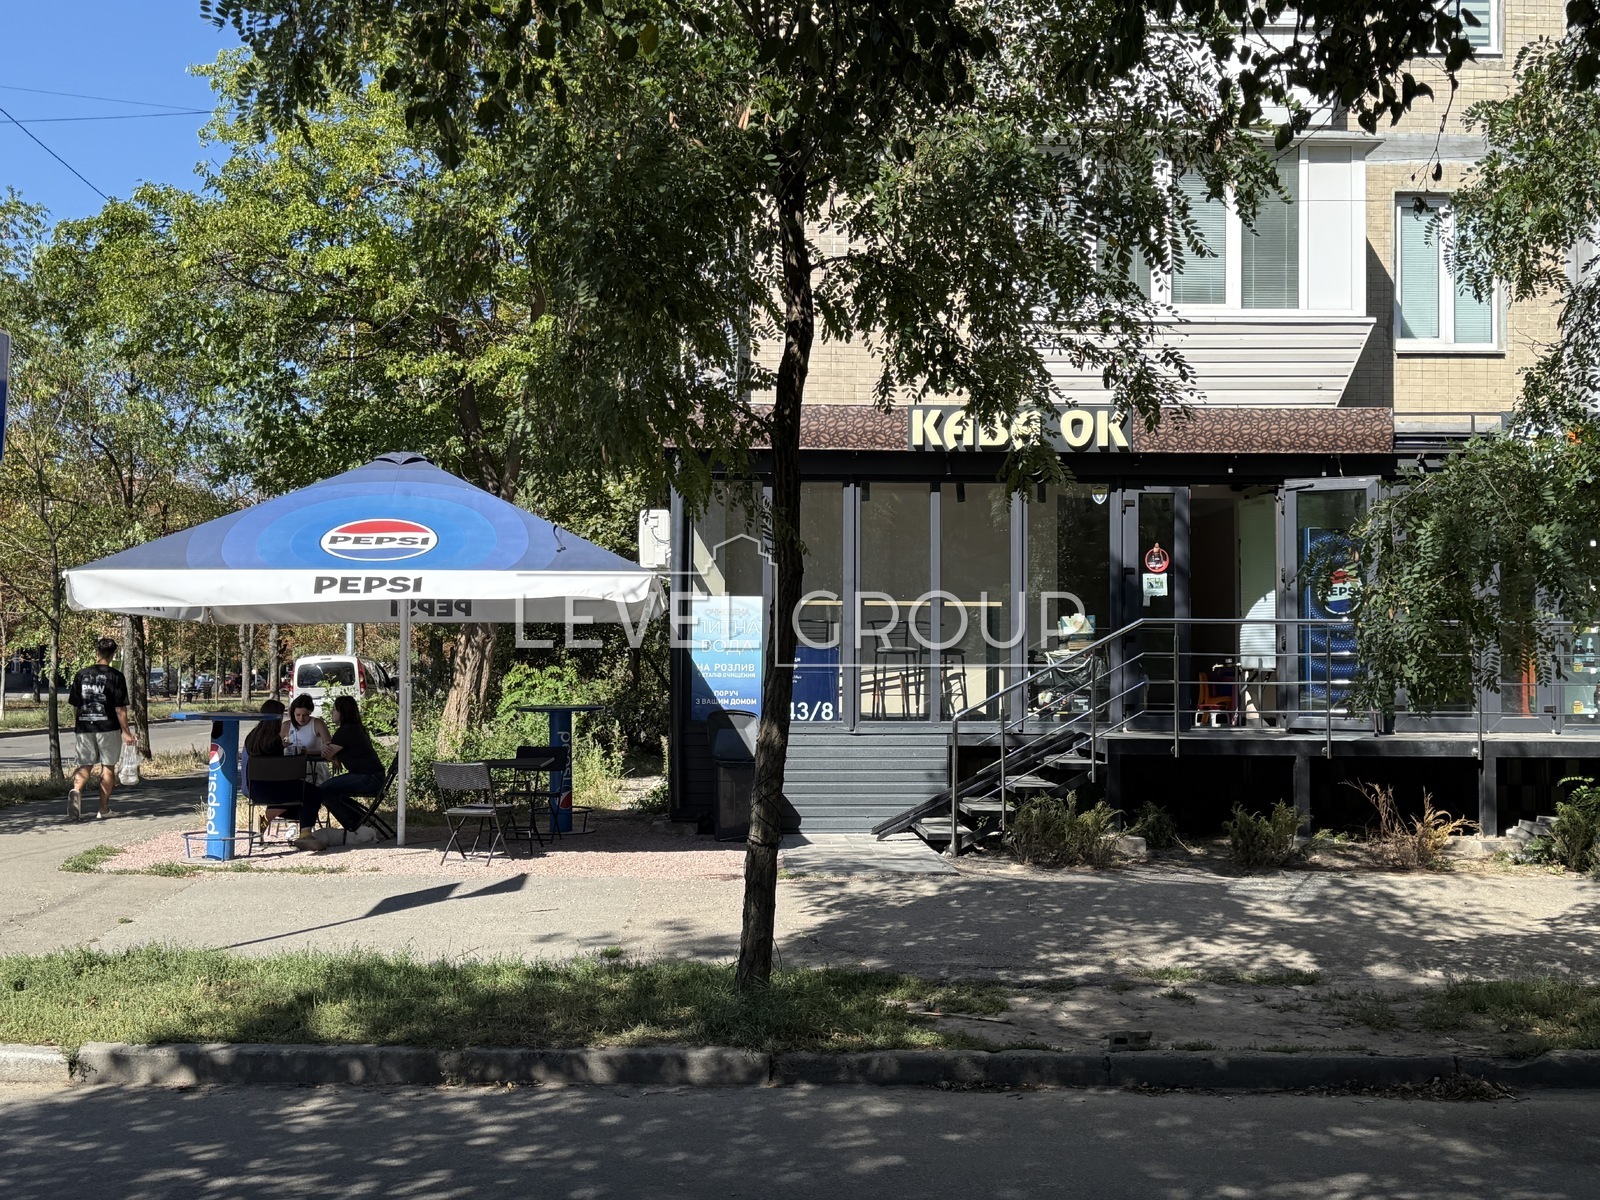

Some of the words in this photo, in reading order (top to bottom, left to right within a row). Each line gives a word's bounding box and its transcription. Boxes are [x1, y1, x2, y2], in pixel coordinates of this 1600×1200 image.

[1060, 409, 1129, 447] ОК
[328, 535, 430, 546] PEPSI
[313, 576, 423, 594] PEPSI
[694, 620, 760, 634] ПИТНА
[701, 639, 754, 655] ВОДА
[696, 663, 711, 672] НА
[714, 663, 755, 672] РОЗЛИВ
[701, 697, 729, 705] ВАШИМ
[730, 697, 757, 706] ДОМОМ
